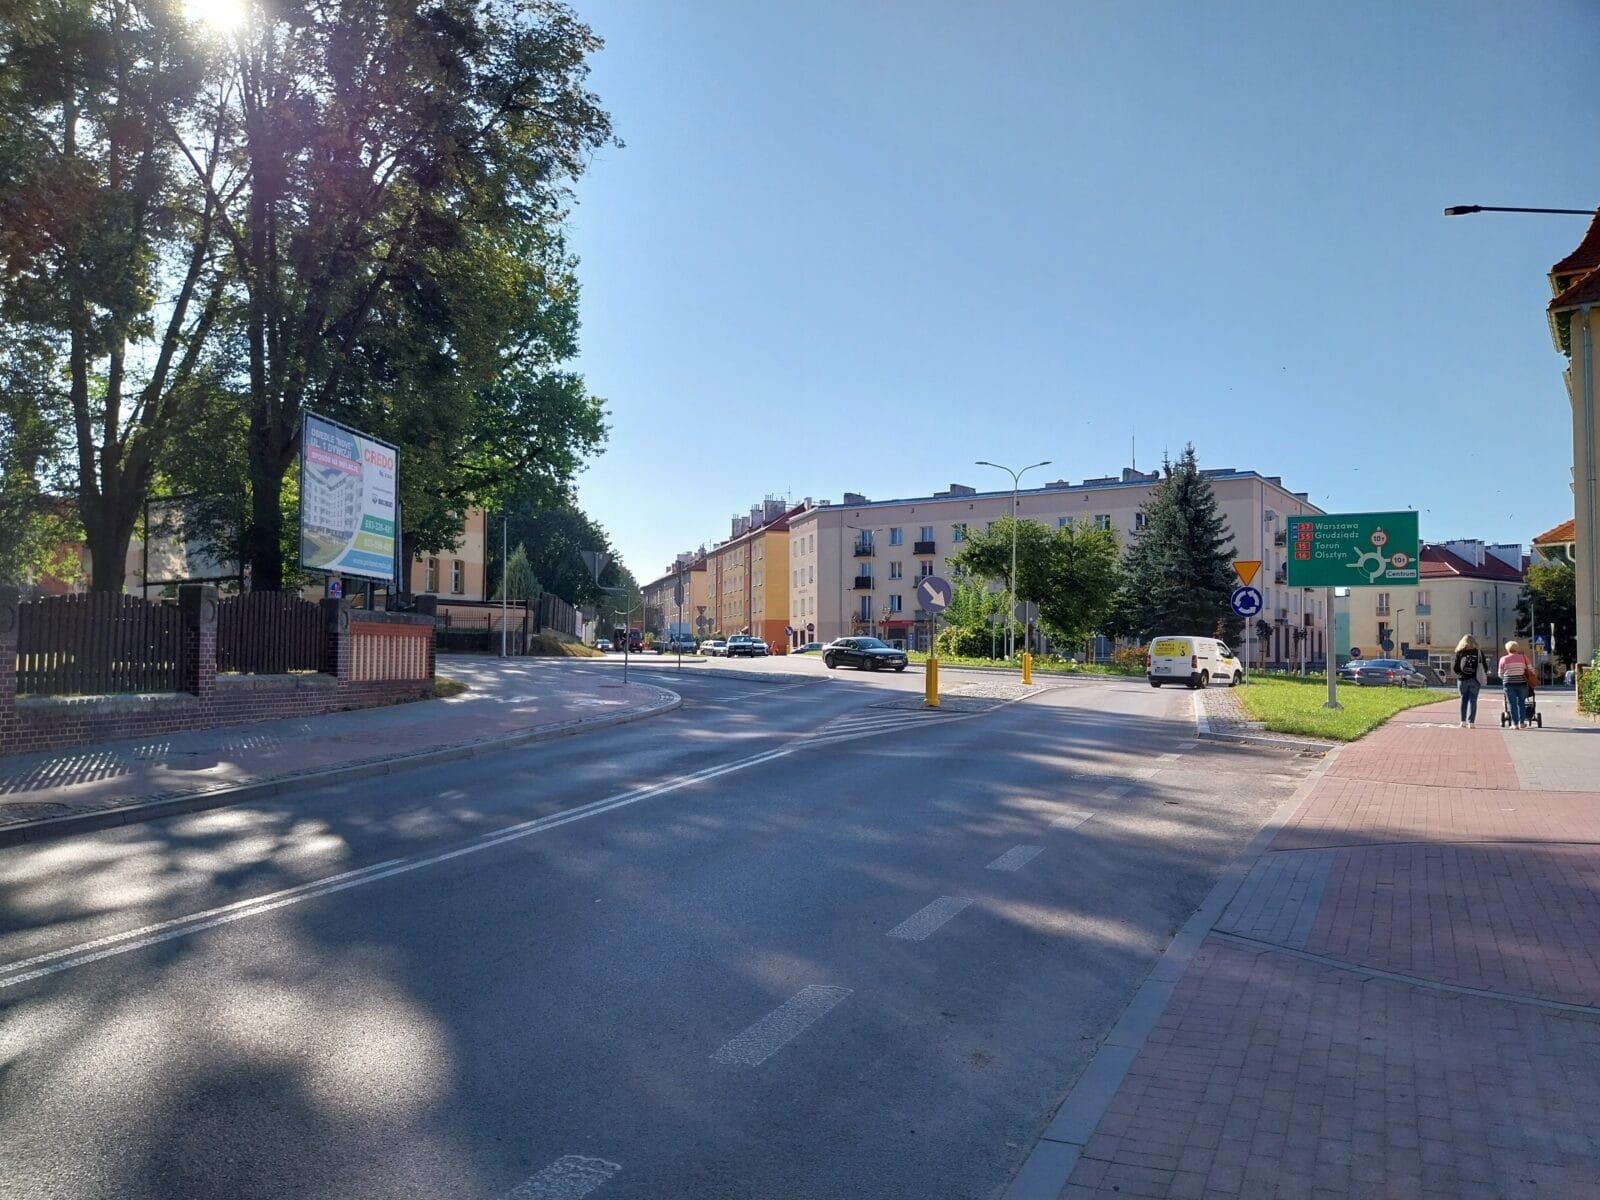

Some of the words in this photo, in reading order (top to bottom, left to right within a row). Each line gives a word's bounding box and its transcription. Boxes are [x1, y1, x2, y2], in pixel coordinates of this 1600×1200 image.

[364, 448, 393, 470] CREDO
[1315, 522, 1359, 530] Warszawa
[1315, 530, 1359, 539] Grudziądz
[1315, 541, 1340, 550] Toruń
[1315, 551, 1347, 560] Olsztyn
